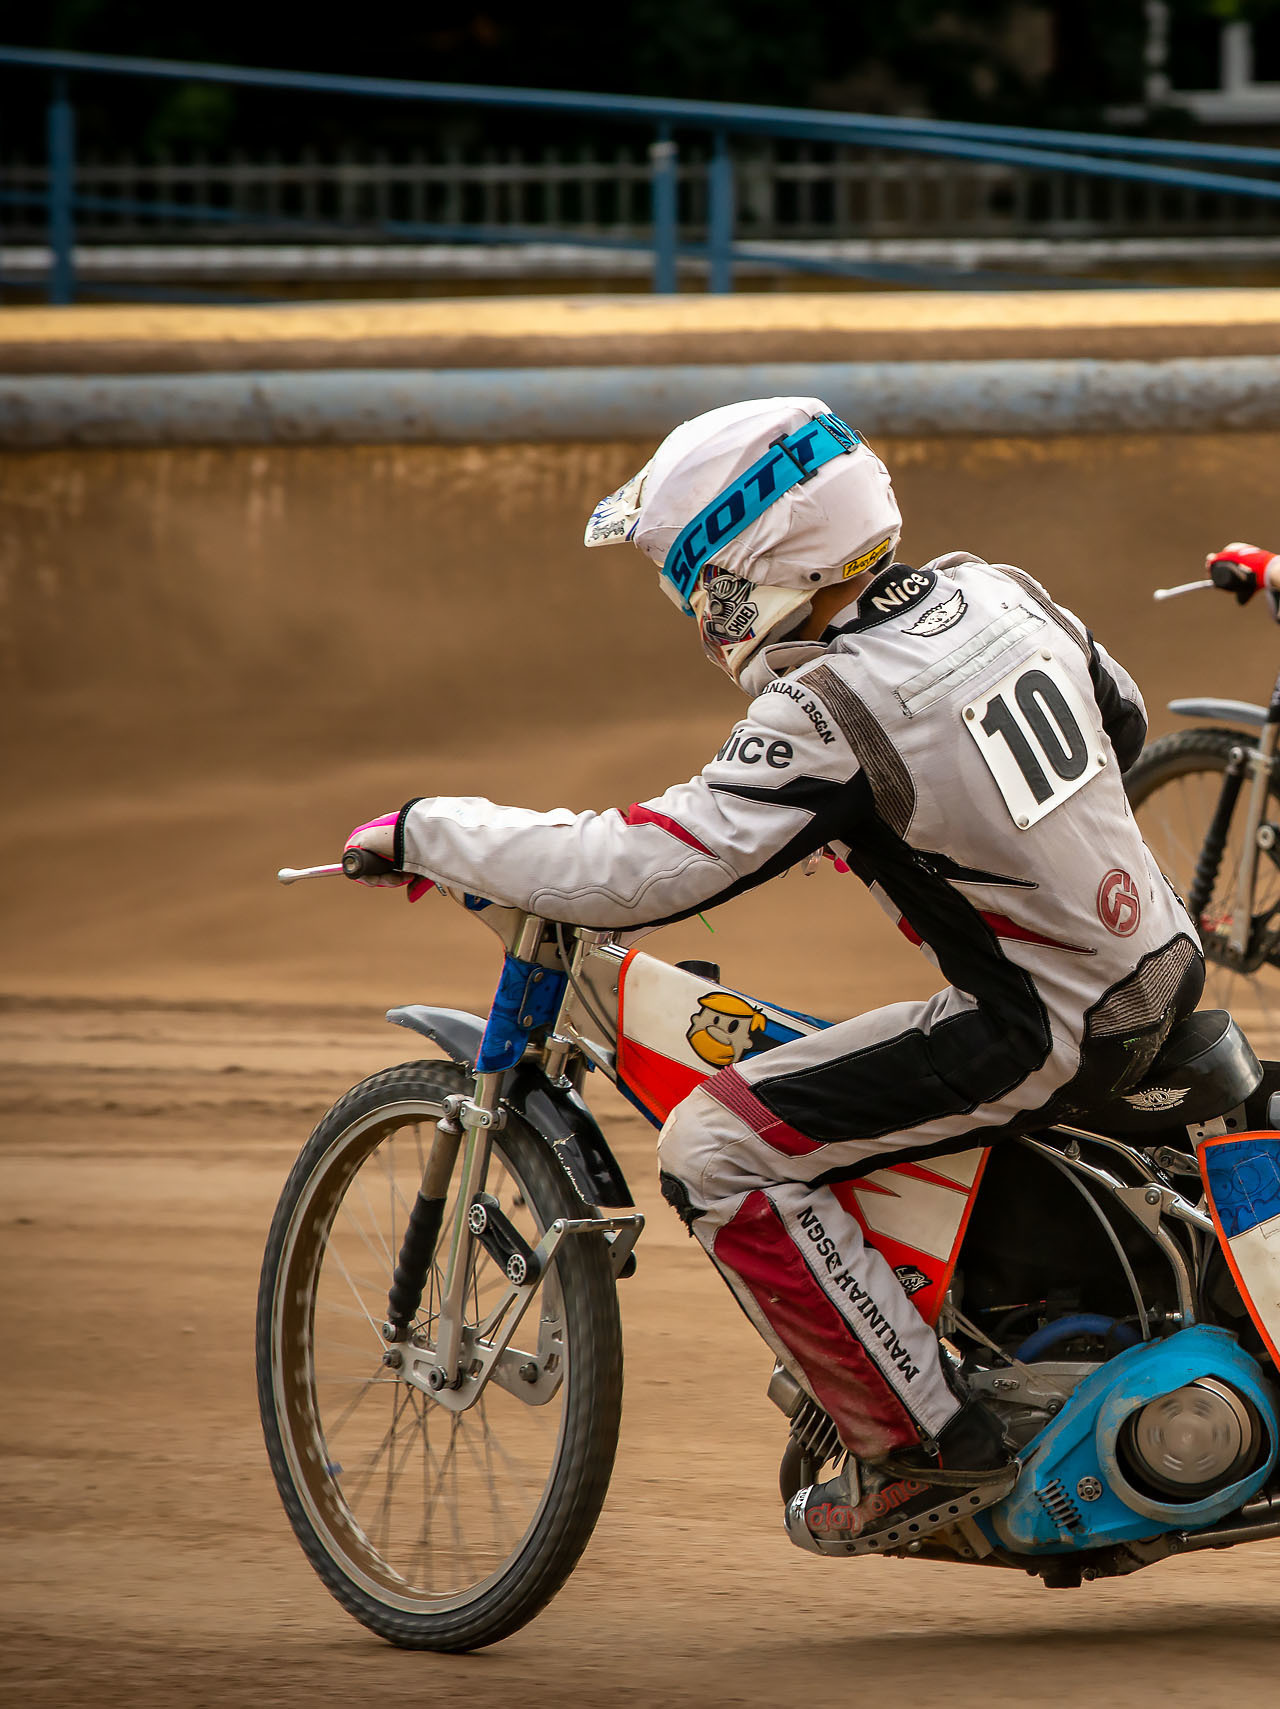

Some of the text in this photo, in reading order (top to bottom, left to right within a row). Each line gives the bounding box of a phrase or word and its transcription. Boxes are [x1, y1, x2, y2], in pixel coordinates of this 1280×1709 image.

[671, 429, 819, 592] SCOTT
[872, 573, 930, 613] Nice
[728, 606, 755, 635] SHOEI
[980, 670, 1088, 805] 10
[806, 1480, 929, 1533] dayona
